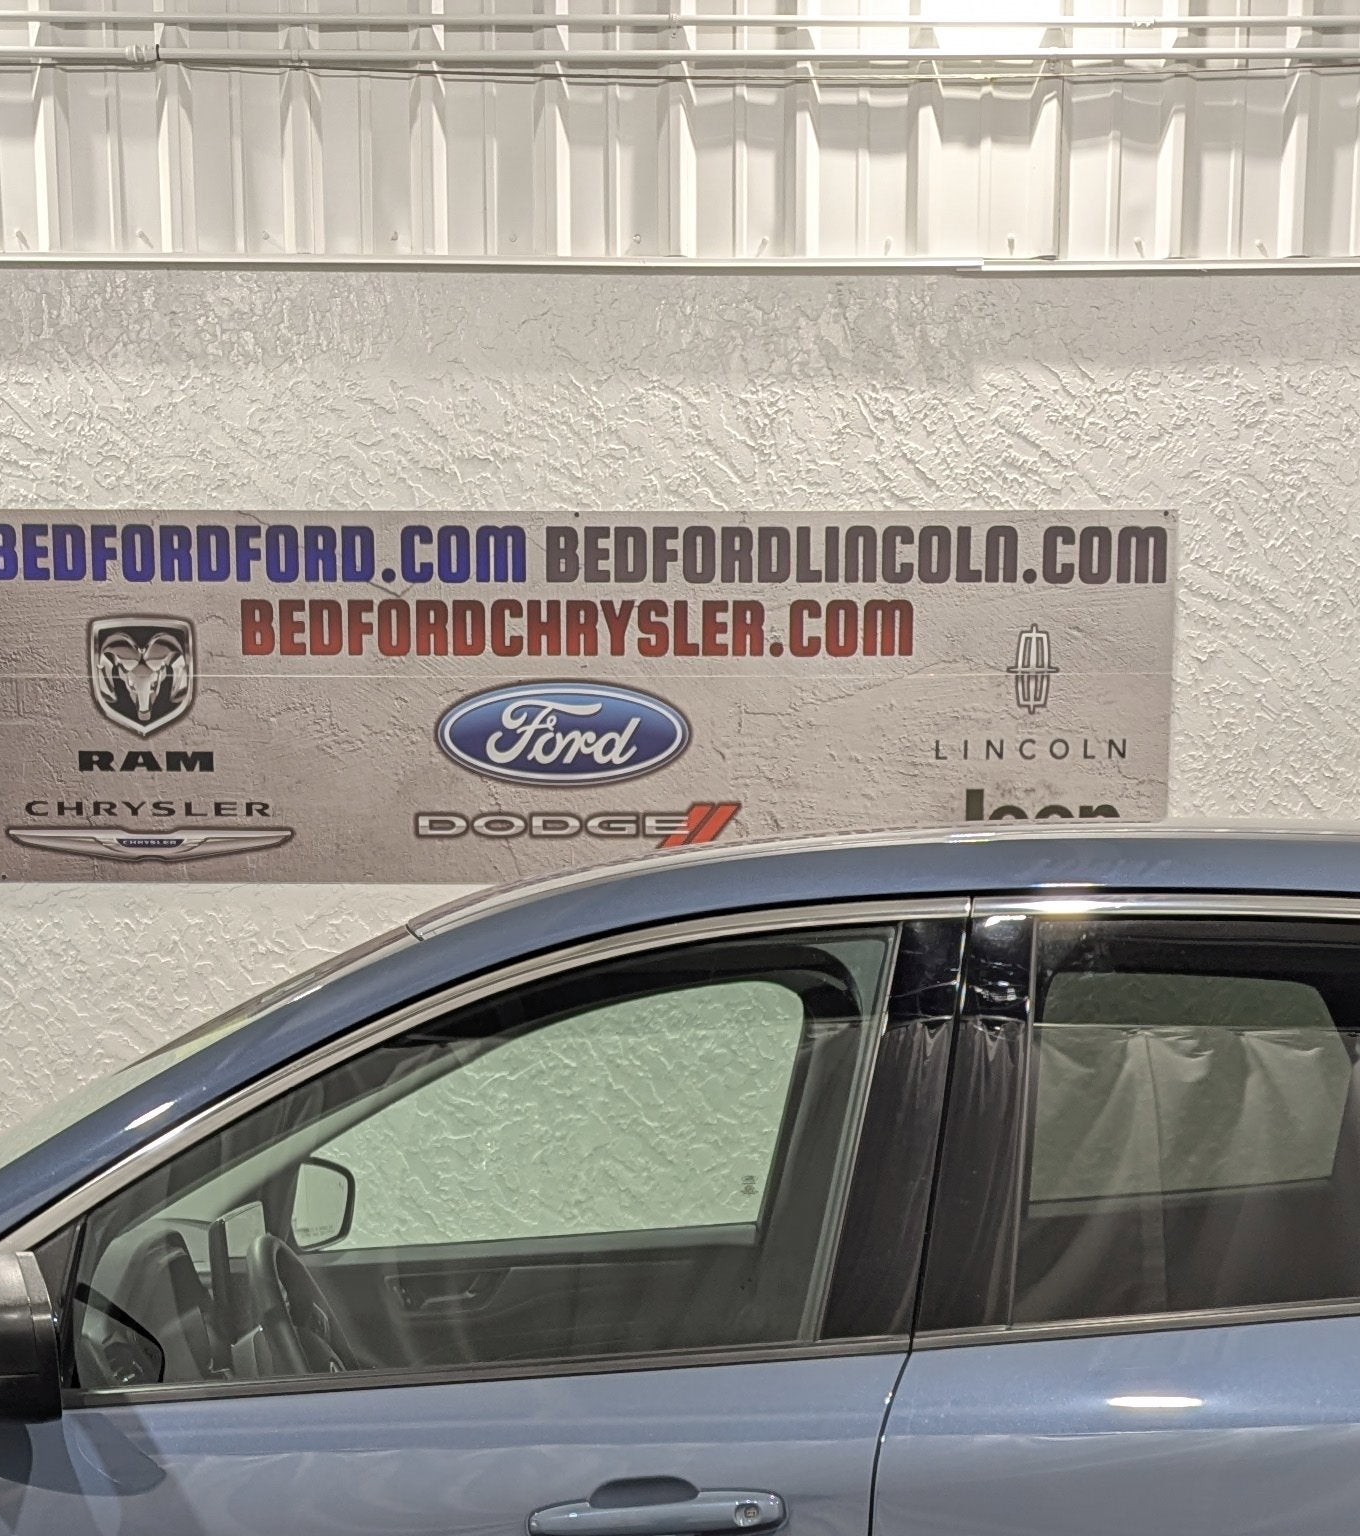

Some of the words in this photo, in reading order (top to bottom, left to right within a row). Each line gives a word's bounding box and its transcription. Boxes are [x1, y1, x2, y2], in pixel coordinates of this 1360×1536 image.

[546, 524, 1168, 585] BEDFORDLINCOLN.COM
[242, 599, 914, 657] BEDFORDCHRYSLER.COM
[485, 699, 641, 766] Ford
[935, 738, 1127, 760] LINCOLN
[78, 750, 215, 773] RAM
[24, 800, 272, 818] CHRYSLER
[417, 815, 691, 838] DODGE
